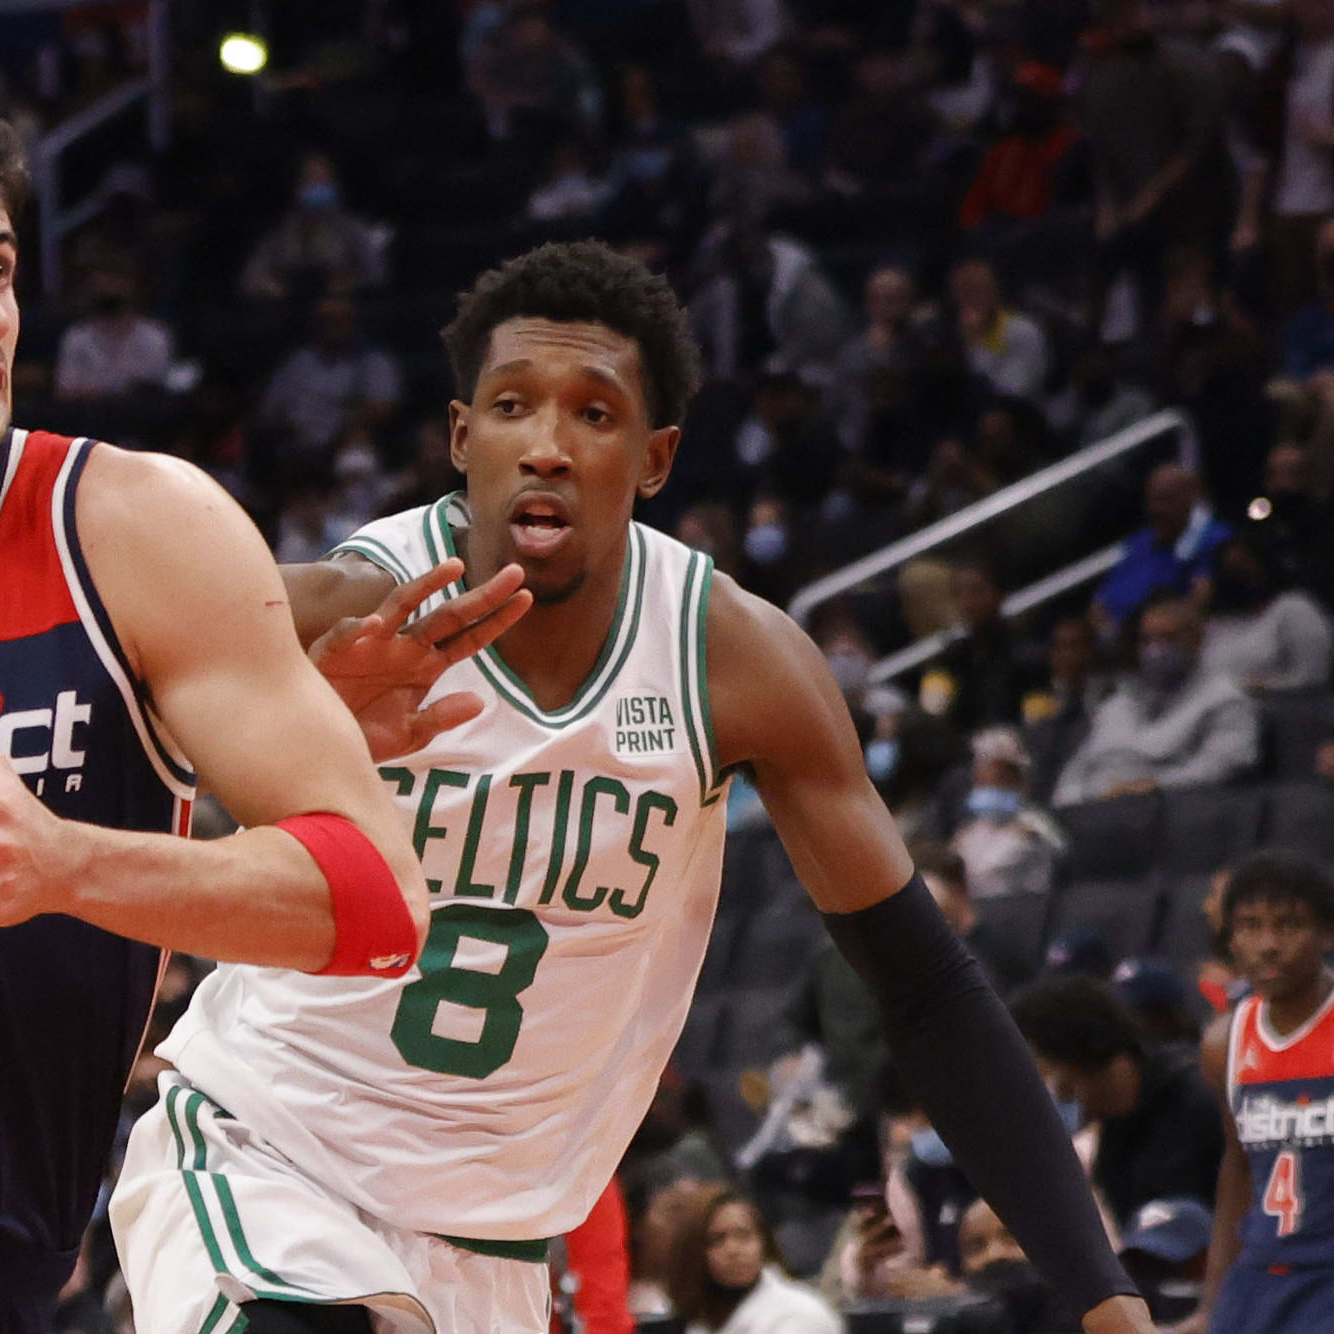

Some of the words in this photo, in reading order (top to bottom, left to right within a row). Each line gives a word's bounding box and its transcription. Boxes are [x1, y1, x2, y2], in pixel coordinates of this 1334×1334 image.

[616, 697, 674, 727] VISTA
[616, 728, 675, 753] PRINT
[390, 903, 549, 1080] 8
[1263, 1150, 1300, 1238] 4
